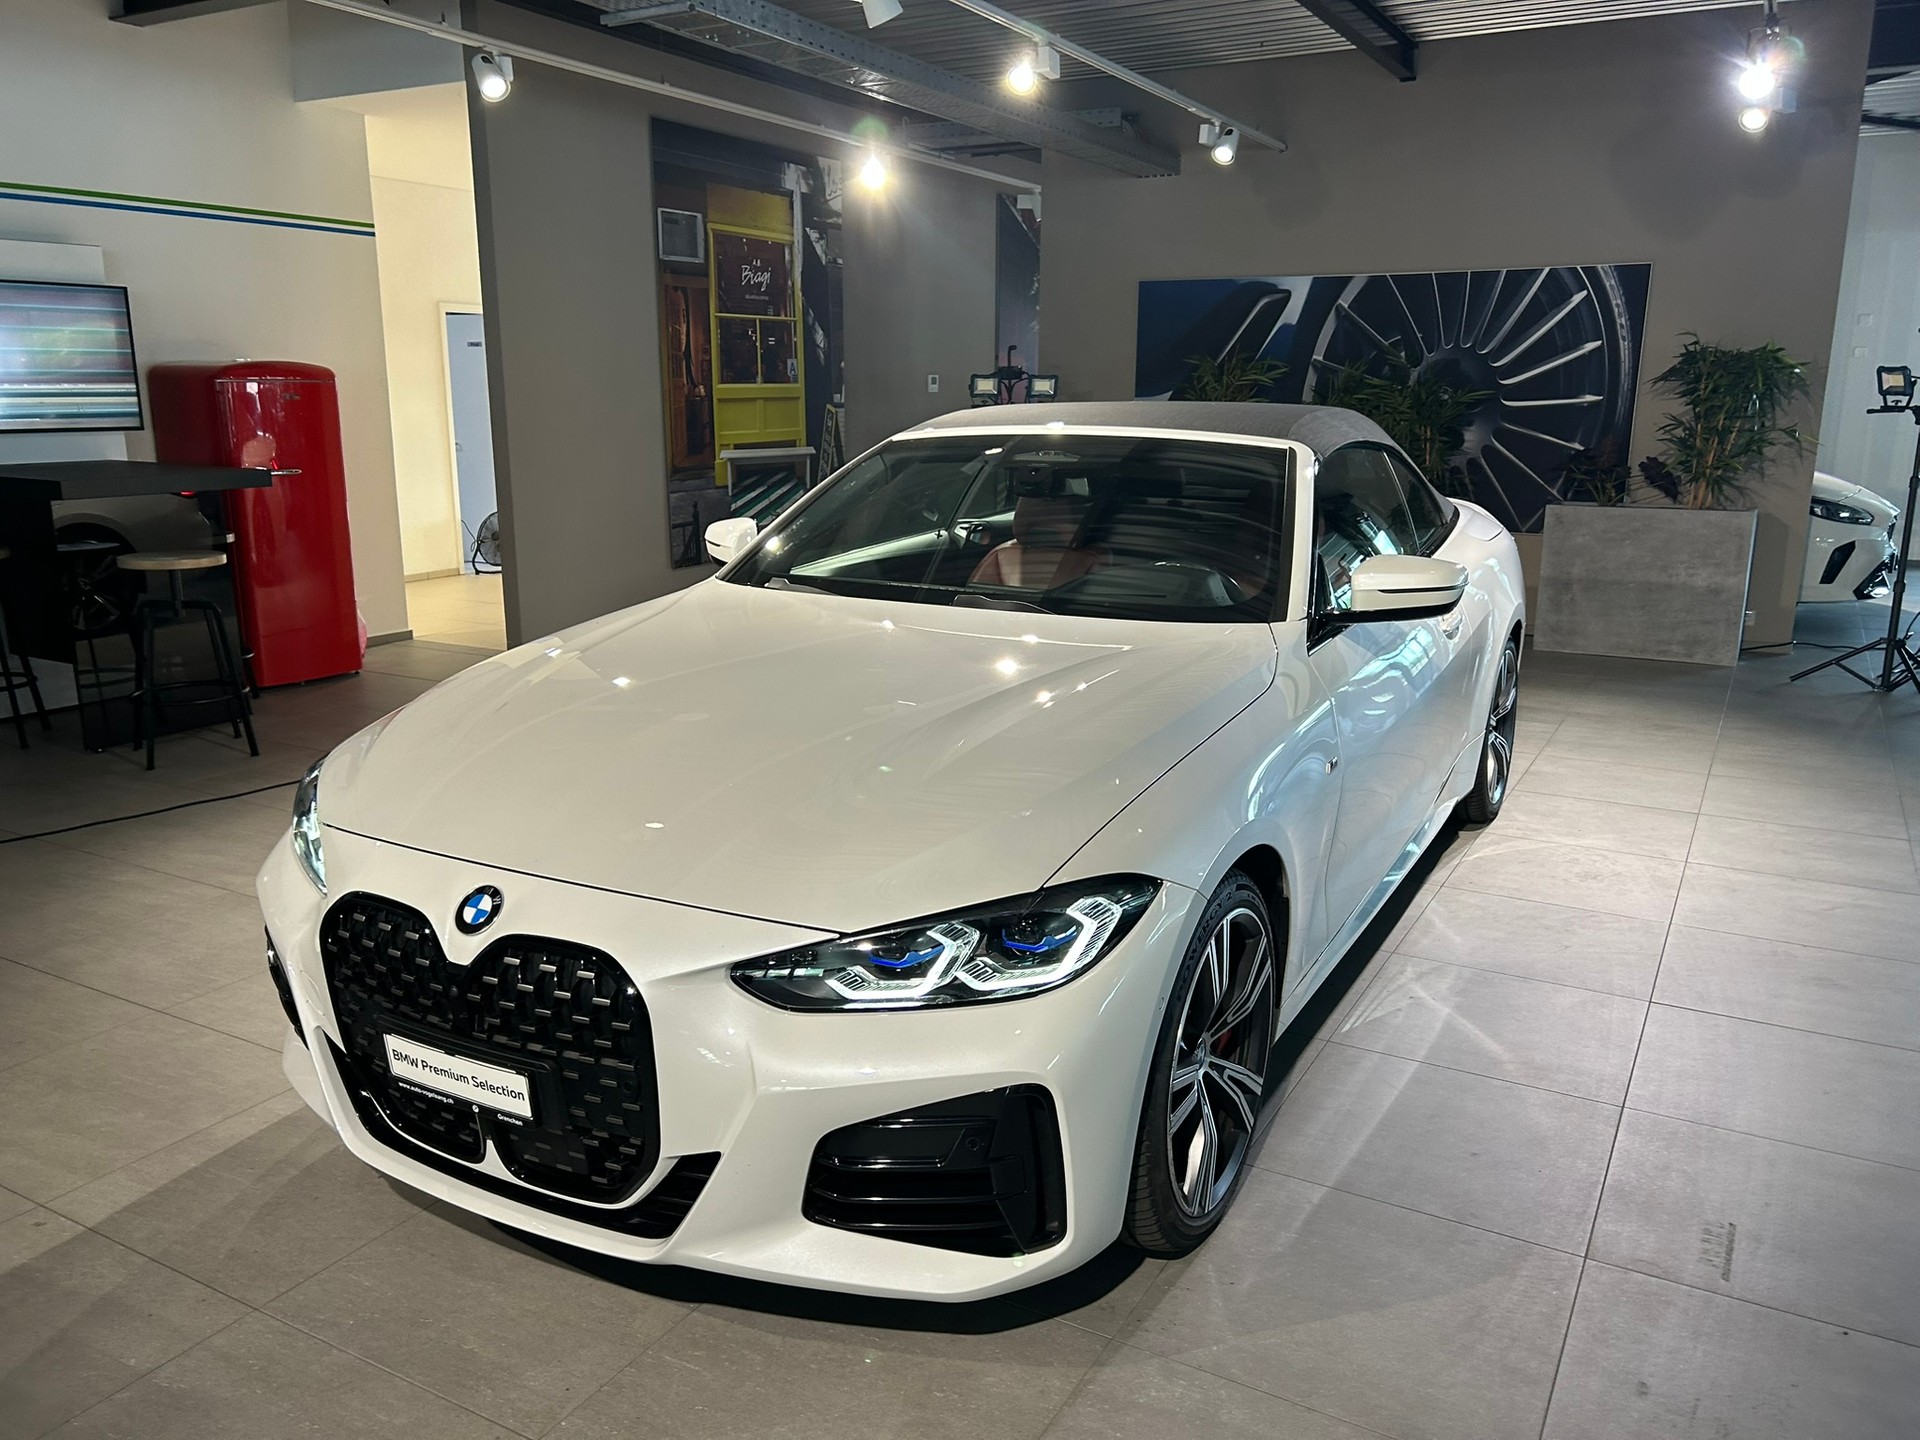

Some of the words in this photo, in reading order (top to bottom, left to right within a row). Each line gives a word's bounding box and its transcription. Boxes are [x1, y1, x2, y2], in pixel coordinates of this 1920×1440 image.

[741, 265, 772, 292] Biagi
[789, 361, 797, 375] A
[1225, 891, 1233, 902] 2
[391, 1048, 419, 1069] BMW
[422, 1059, 470, 1085] Premium
[471, 1075, 526, 1102] Selection
